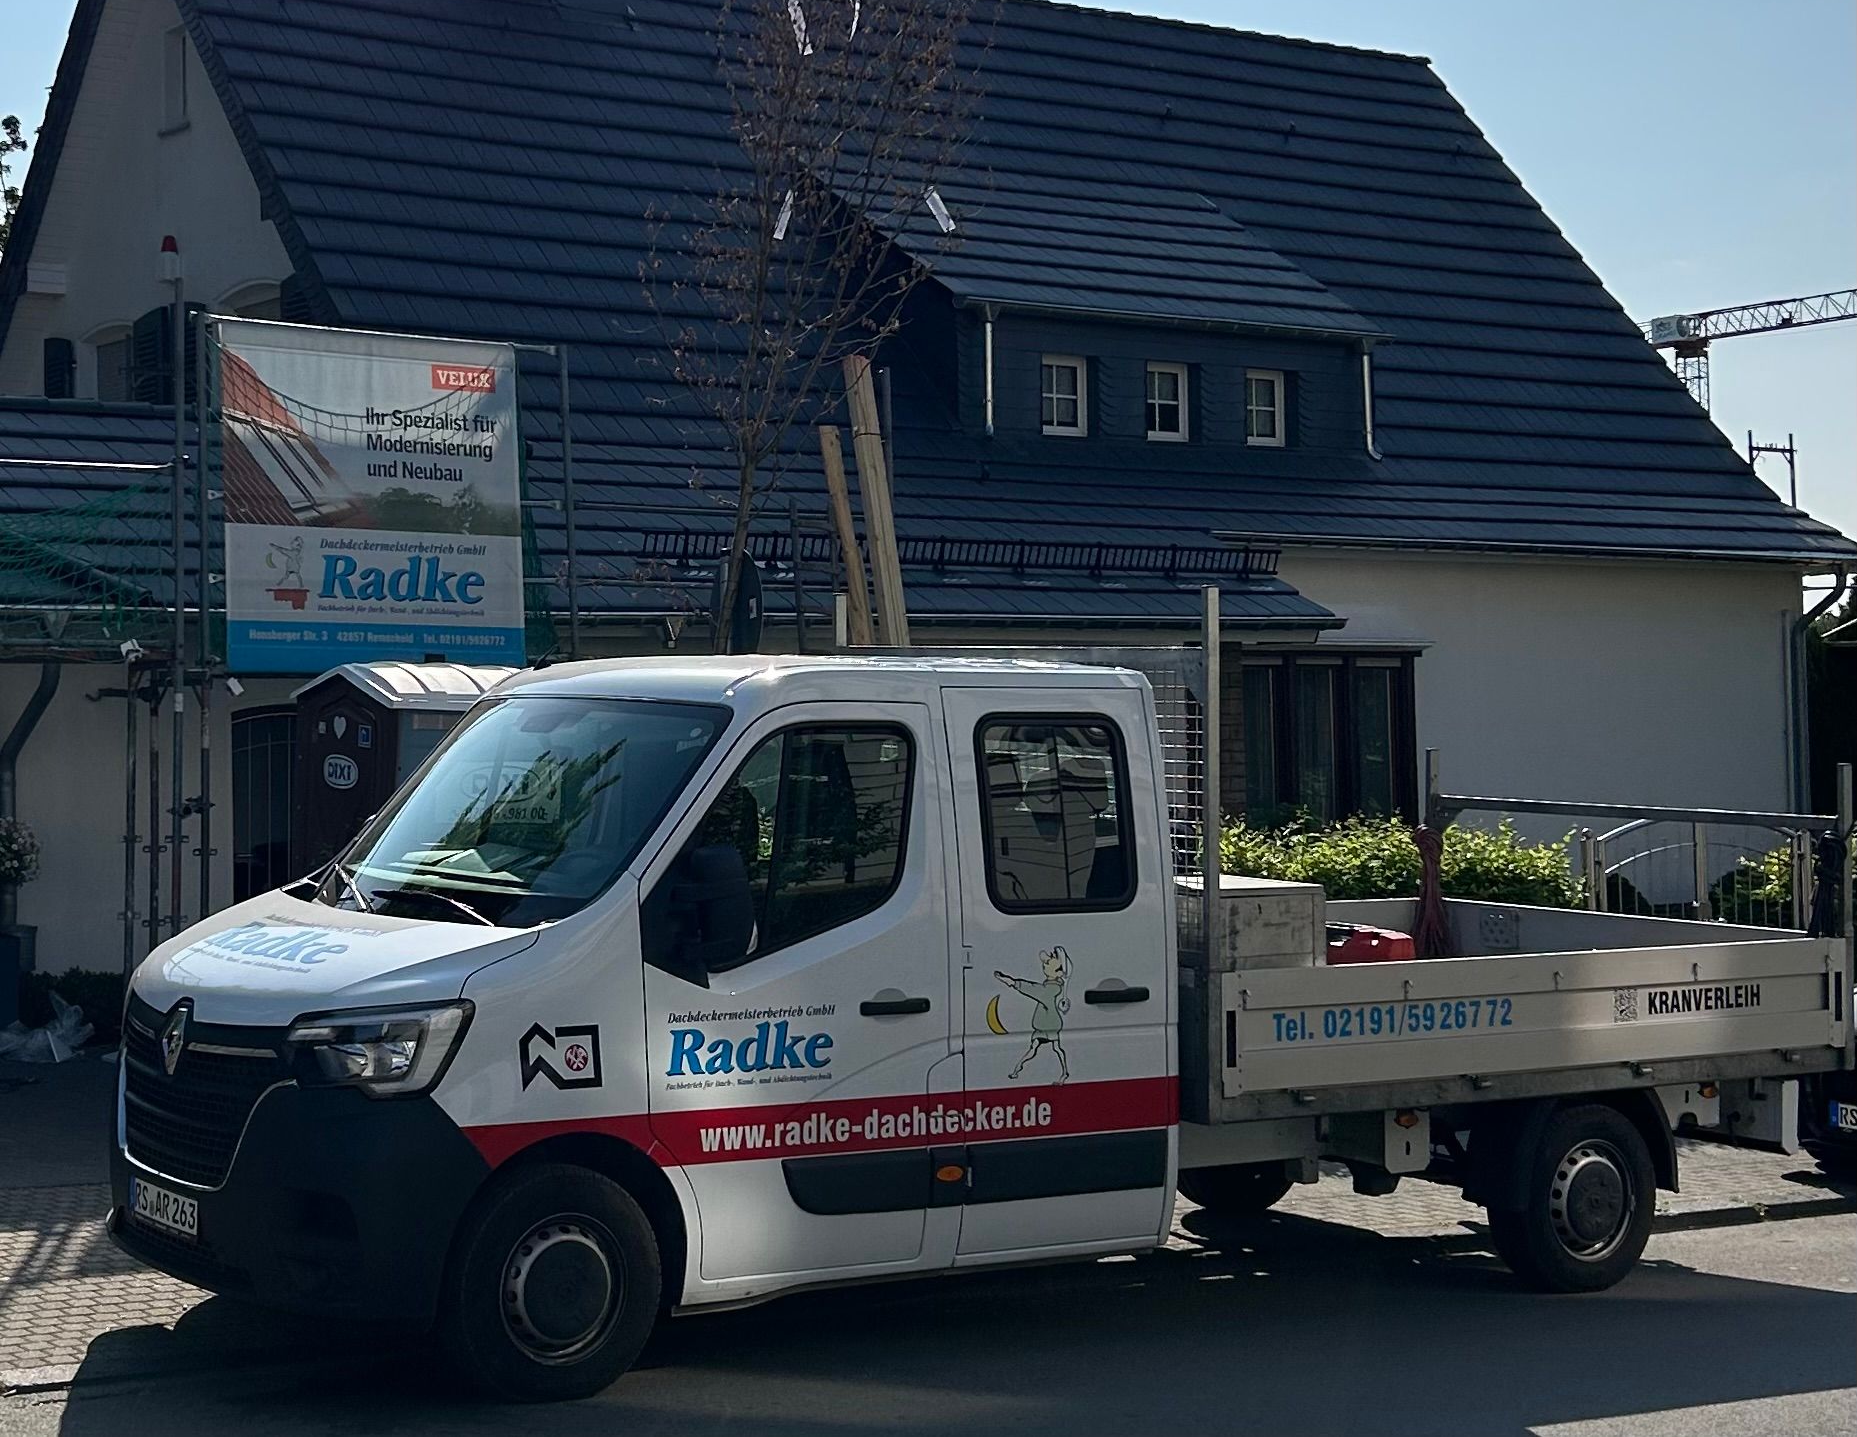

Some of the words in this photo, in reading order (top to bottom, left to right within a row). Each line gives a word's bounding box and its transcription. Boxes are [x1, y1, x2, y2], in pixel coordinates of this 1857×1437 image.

[436, 369, 491, 387] VELUX
[366, 407, 388, 425] Ihr
[392, 410, 469, 431] Spezialist
[472, 415, 497, 433] für
[366, 433, 493, 462] Modernisierung
[367, 460, 397, 477] und
[402, 462, 463, 481] Neubau
[319, 538, 454, 554] Dachdeckermeisterbetrieb
[317, 554, 486, 605] Radke
[667, 1005, 804, 1024] Dachdeckermeisterbetrieb
[806, 1004, 836, 1017] GmbH
[1647, 984, 1761, 1015] KRANVERLEIH
[1272, 1011, 1314, 1042] Tel.
[665, 1019, 834, 1077] Radke
[700, 1097, 1053, 1153] www.radke-dachdecker.de
[136, 1182, 149, 1212] RS
[155, 1190, 170, 1222] AR
[171, 1197, 196, 1230] 263
